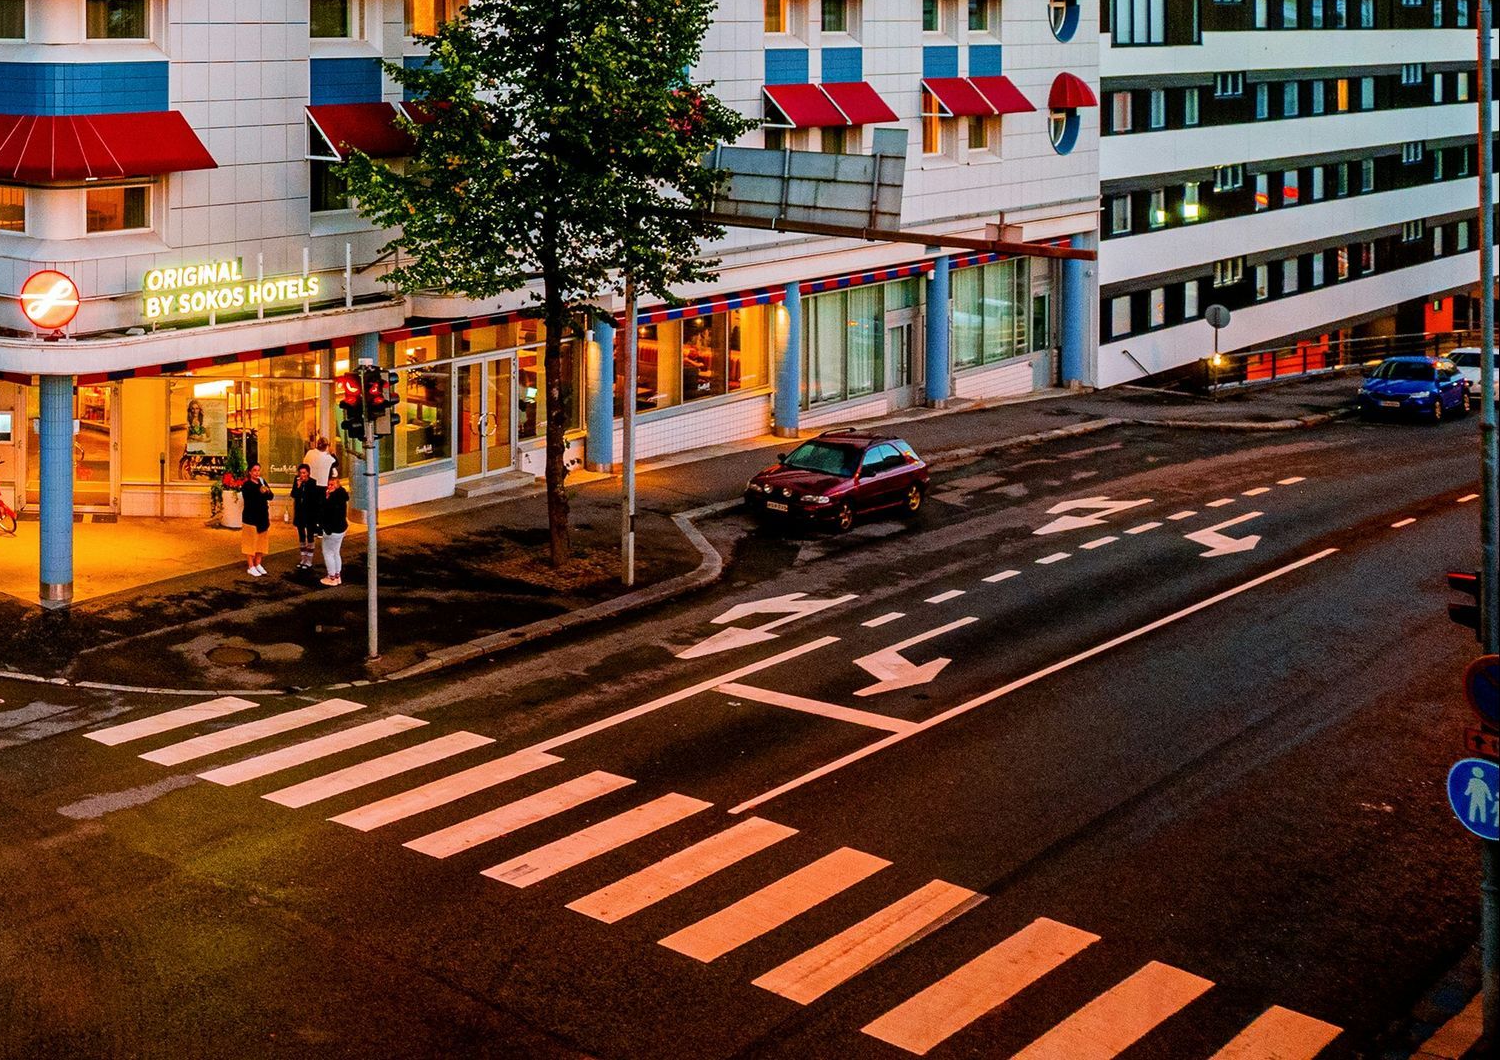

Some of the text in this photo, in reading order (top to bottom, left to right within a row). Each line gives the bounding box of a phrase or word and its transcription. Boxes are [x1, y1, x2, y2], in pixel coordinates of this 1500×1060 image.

[146, 260, 243, 291] ORIGINAL
[146, 277, 320, 318] BY SOKOS HOTELS
